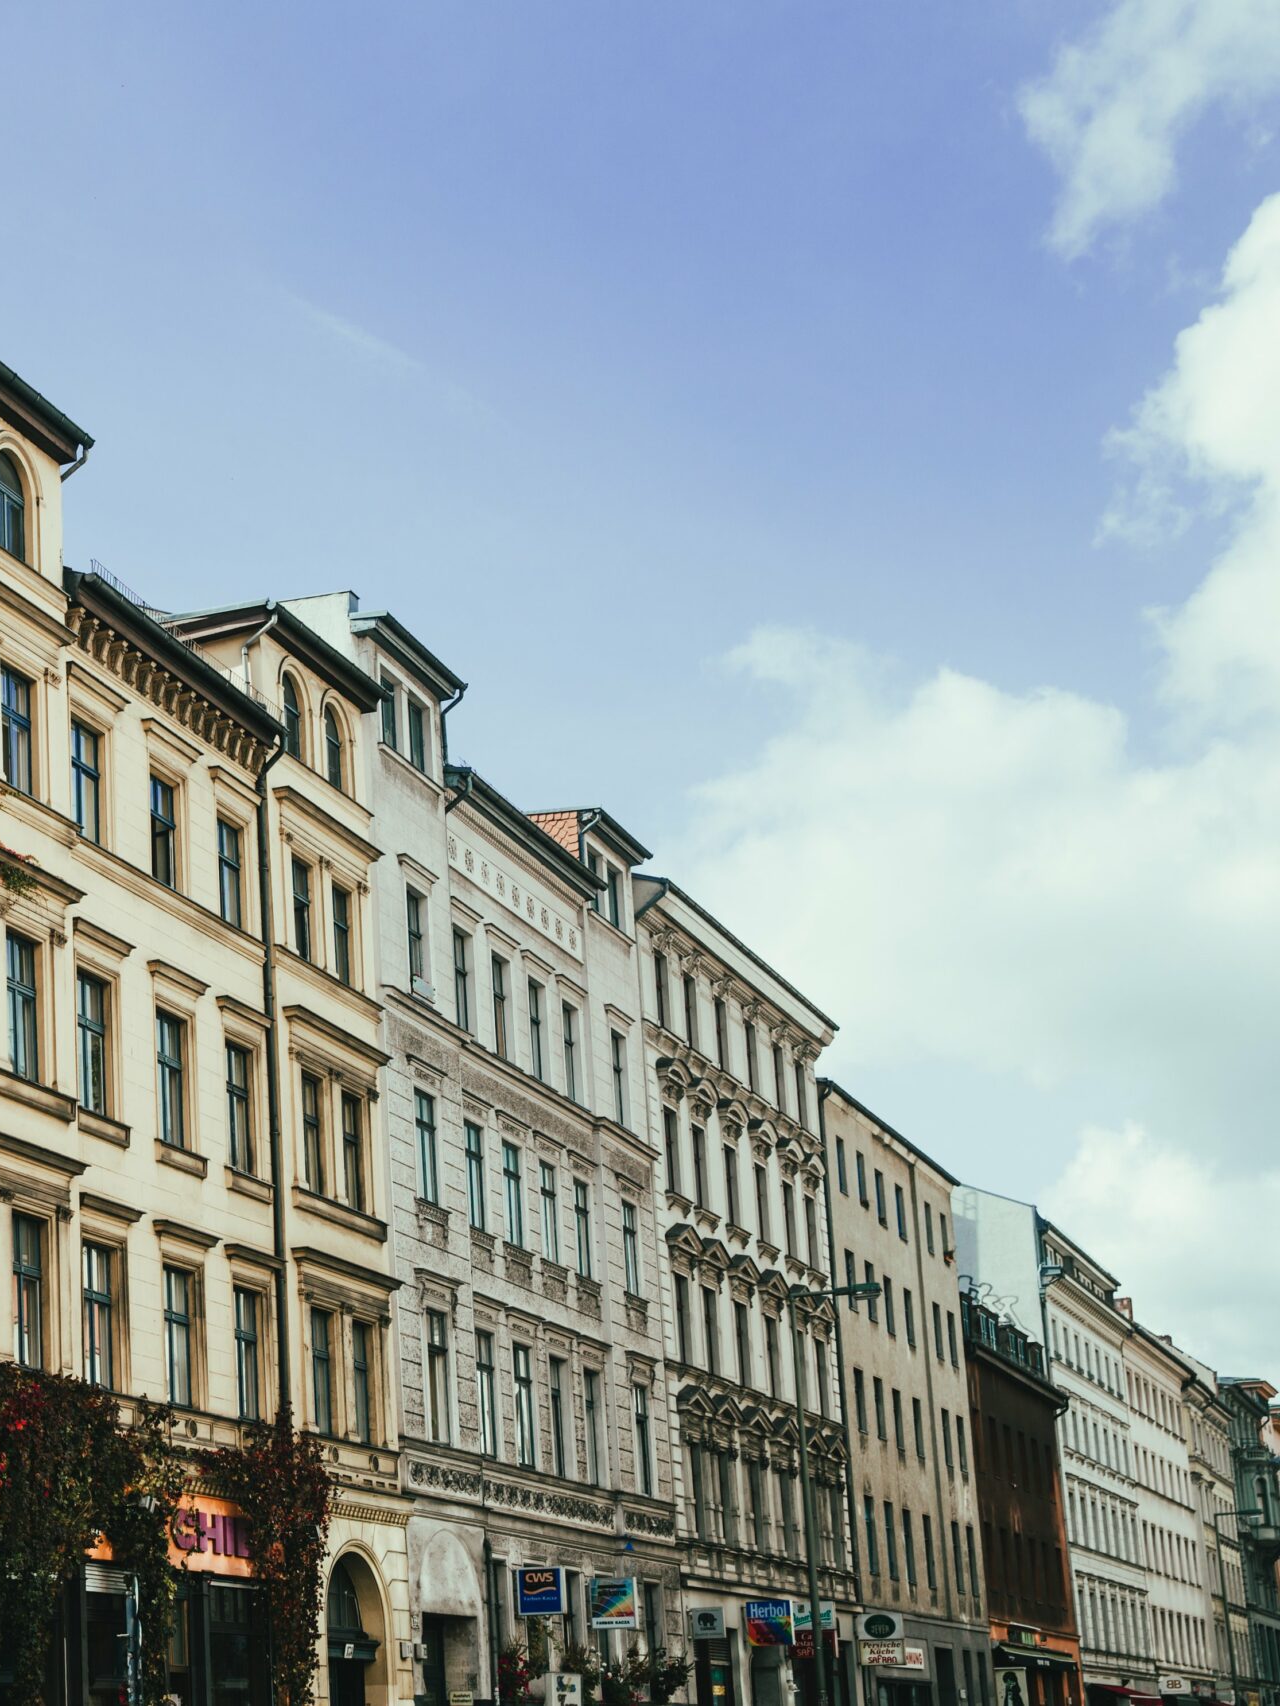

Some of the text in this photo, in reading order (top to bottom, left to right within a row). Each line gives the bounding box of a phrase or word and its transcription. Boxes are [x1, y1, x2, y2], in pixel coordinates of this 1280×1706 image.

[525, 1572, 554, 1583] CWS
[750, 1601, 787, 1618] Herbol
[863, 1641, 901, 1649] Persische
[867, 1654, 898, 1664] SAFRAN
